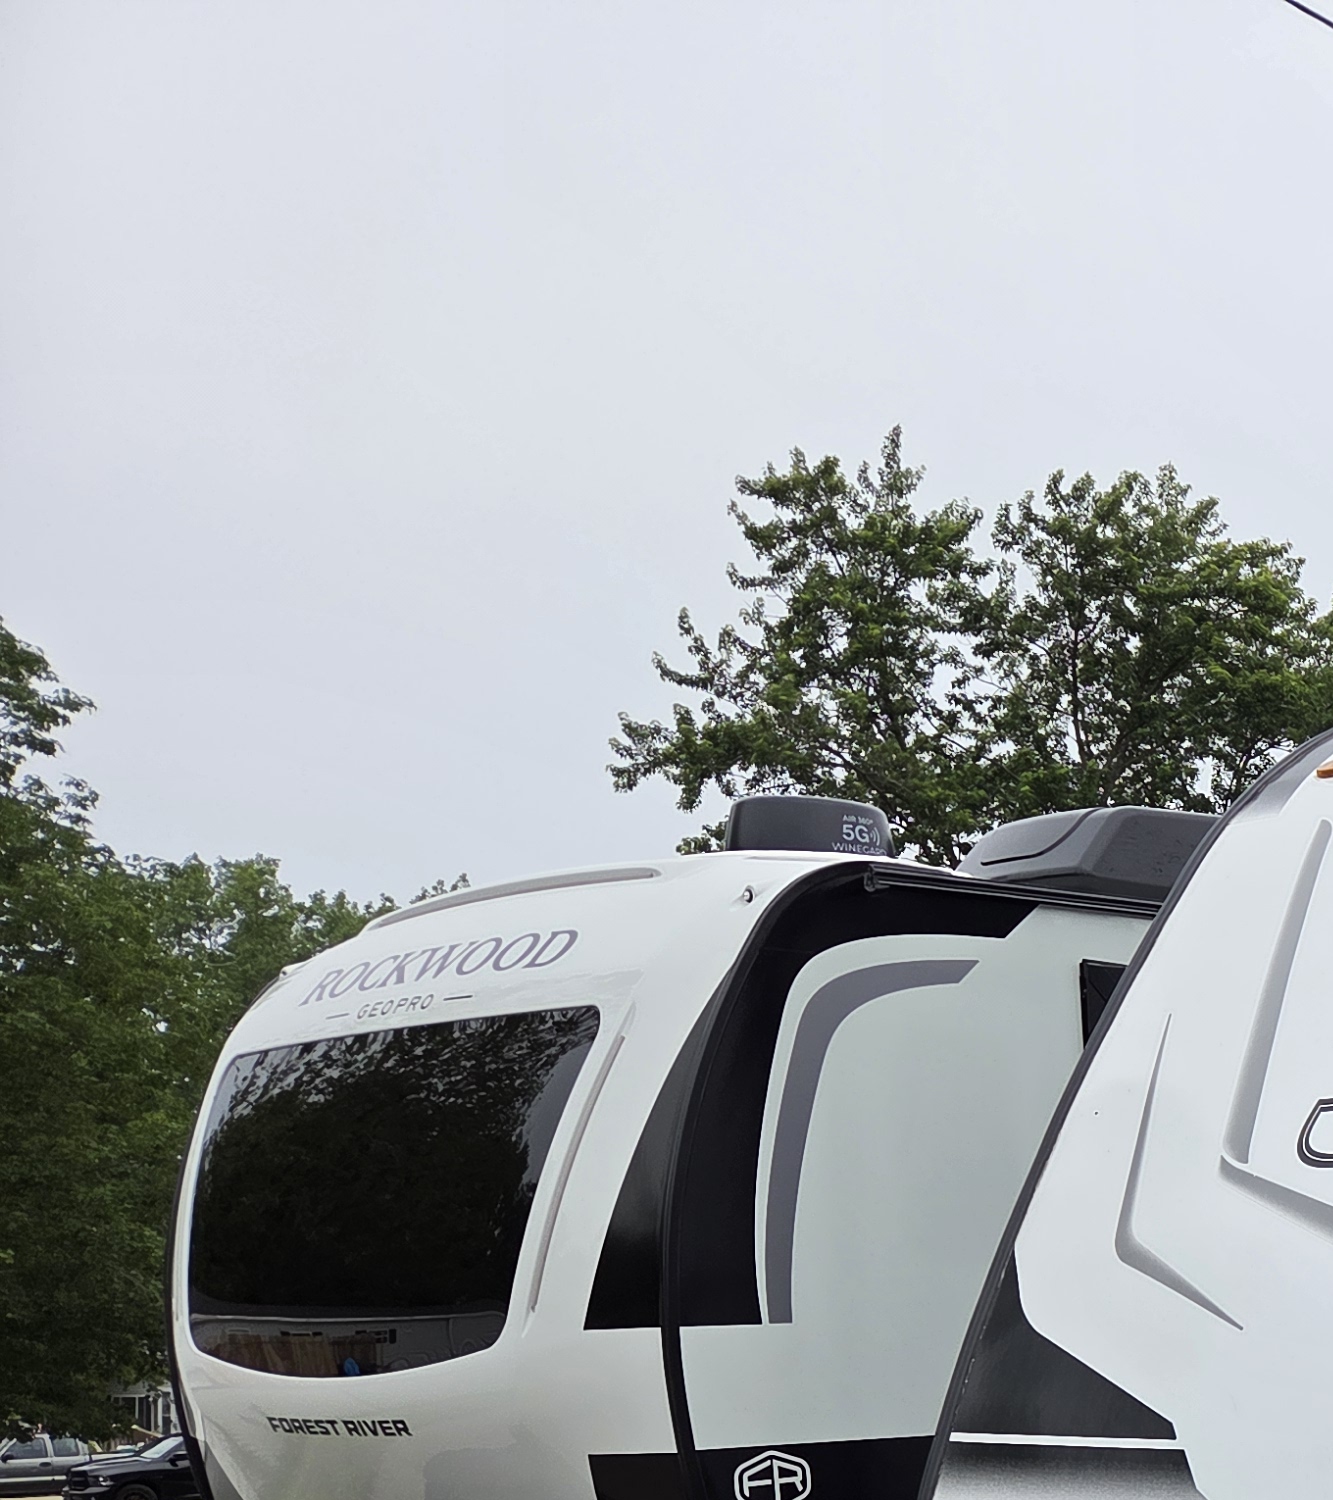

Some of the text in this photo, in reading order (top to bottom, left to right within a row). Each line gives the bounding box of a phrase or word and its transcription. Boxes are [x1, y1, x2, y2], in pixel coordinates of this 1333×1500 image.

[842, 824, 869, 843] 5G
[298, 929, 579, 1007] ROCKWOOD
[356, 994, 434, 1020] GEOPRO
[266, 1416, 413, 1437] FOREST RIVER
